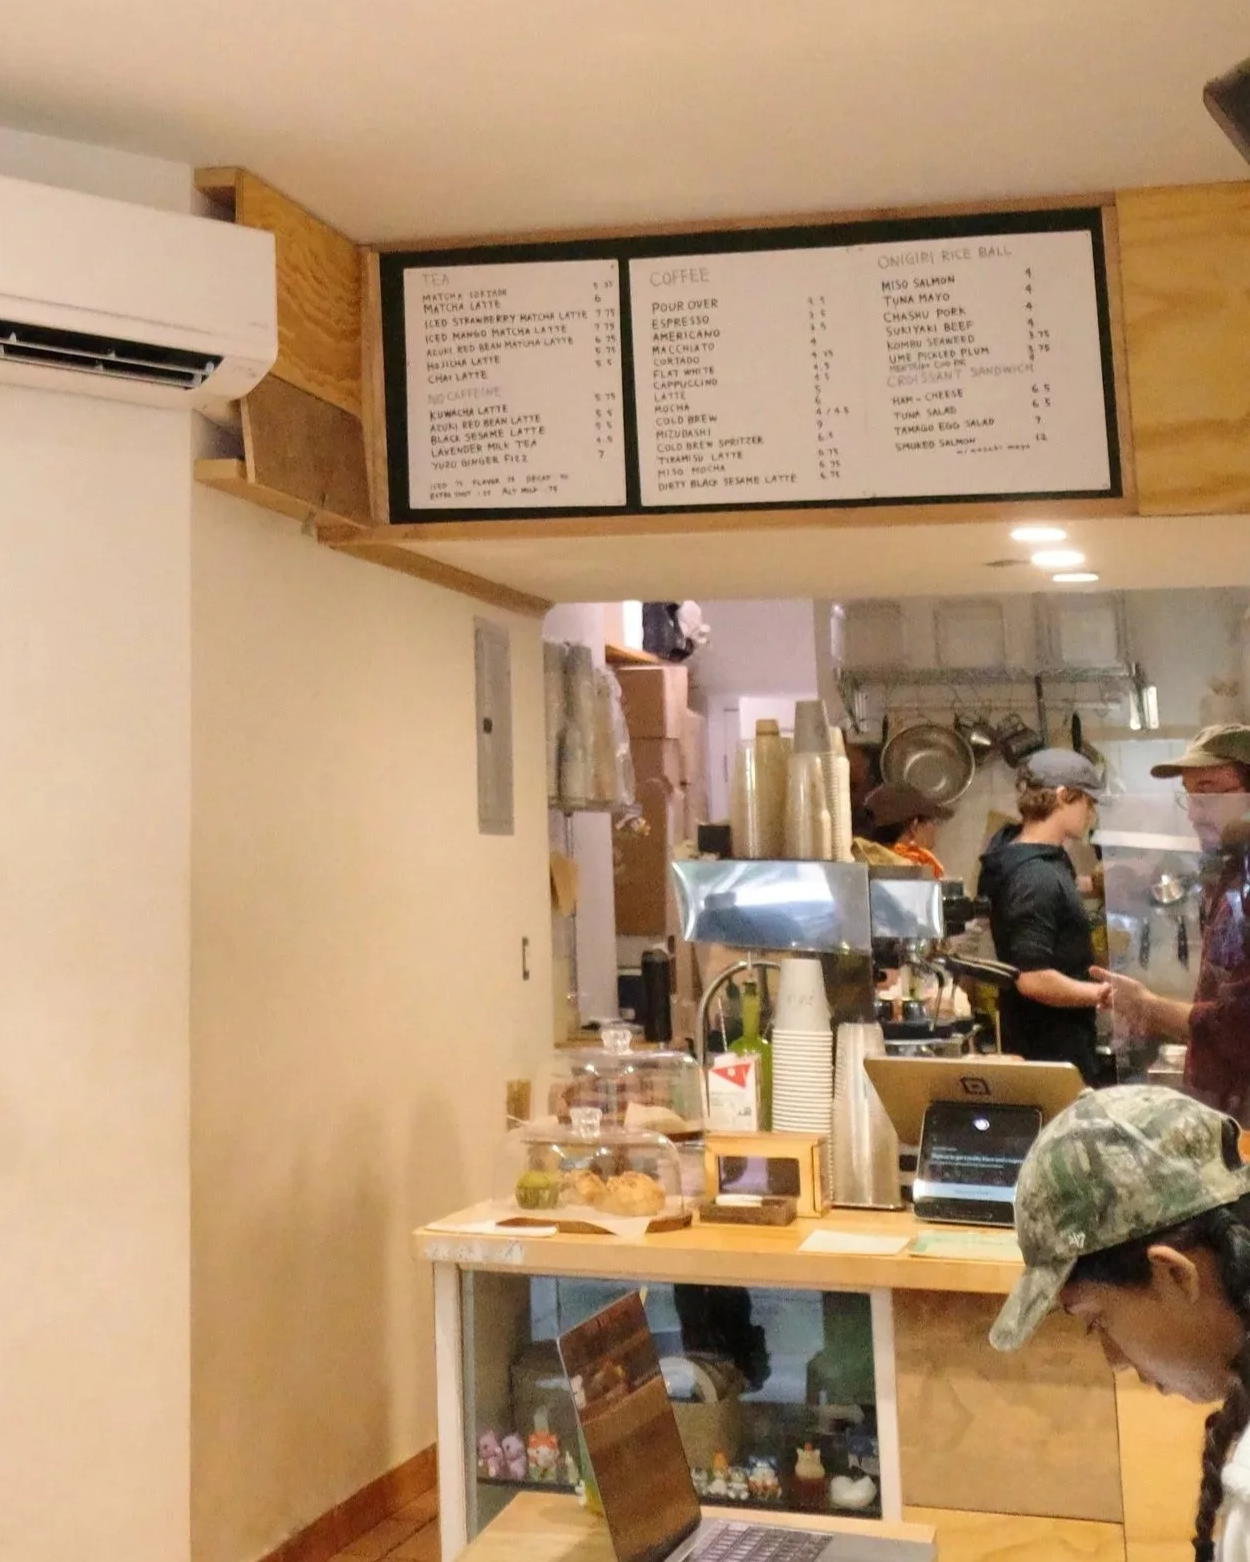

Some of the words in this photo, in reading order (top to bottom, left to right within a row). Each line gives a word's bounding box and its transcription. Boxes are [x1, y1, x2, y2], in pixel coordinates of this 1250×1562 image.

[878, 252, 935, 270] ONIGIRI
[942, 248, 971, 262] RICE
[979, 245, 1012, 258] BALL
[422, 273, 449, 286] TEA
[650, 268, 710, 287] COFFEE
[882, 280, 909, 291] MISO
[914, 275, 955, 288] SALMON
[422, 292, 462, 304] MATCHA
[652, 301, 684, 314] POUR
[687, 298, 718, 311] OVER
[884, 295, 914, 308] TUNA
[919, 292, 950, 302] MAYO
[423, 302, 464, 314] MATCHA
[470, 300, 500, 311] LATTE
[884, 310, 929, 323] CHASHU
[937, 307, 966, 318] PORK
[425, 319, 447, 329] ICED
[452, 315, 516, 326] STRAWBERRY
[520, 312, 555, 322] MATCHA
[559, 310, 588, 320] LATTE
[652, 316, 710, 329] ESPRESSO
[425, 334, 447, 343] ICED
[452, 330, 487, 340] MANGO
[492, 328, 530, 337] MATCHA
[535, 325, 567, 334] LATTE
[652, 329, 721, 342] AMERICANO
[886, 324, 938, 337] SUKIYAKI
[944, 320, 973, 332] BEEF
[457, 344, 475, 354] RED
[480, 341, 501, 352] BEAN
[504, 338, 541, 350] MATCHA
[544, 336, 574, 347] LATTE
[652, 342, 715, 355] MACCHIATO
[887, 339, 922, 351] KOMBU
[927, 335, 975, 347] SEAWEED
[471, 355, 500, 366] LATTE
[654, 357, 700, 366] CORTADO
[889, 354, 911, 364] UME
[918, 350, 956, 360] PICKLED
[961, 347, 990, 357] PLUM
[456, 370, 488, 381] LATTE
[653, 369, 679, 379] FLAT
[683, 366, 714, 376] WHITE
[886, 370, 962, 388] CROISSANT
[971, 364, 1036, 378] SANDWICH
[428, 393, 444, 405] NO
[447, 387, 502, 402] CAFFEINE
[655, 392, 686, 402] LATTE
[893, 396, 913, 406] HAM
[925, 389, 964, 402] CHEESE
[430, 408, 474, 420] KUWACHA
[478, 404, 508, 416] LATTE
[655, 404, 690, 414] MOCHA
[894, 411, 920, 420] TUNA
[927, 406, 957, 417] SALAD
[462, 419, 480, 430] RED
[483, 416, 507, 428] BEAN
[511, 414, 541, 425] LATTE
[656, 416, 684, 426] COLD
[687, 414, 718, 425] BREW
[894, 424, 934, 436] TAMAGO
[938, 422, 959, 432] EGG
[965, 418, 995, 428] SALAD
[430, 434, 460, 446] BLACK
[465, 430, 504, 442] SESAME
[510, 425, 546, 436] LATTE
[656, 429, 711, 439] MIZUDASHI
[432, 444, 482, 458] LAVENDER
[488, 441, 509, 452] MILK
[517, 439, 537, 449] TEA
[657, 442, 683, 453] COLD
[686, 440, 713, 451] BREW
[718, 436, 764, 448] SPRITZER
[895, 441, 935, 452] SMOKED
[939, 437, 976, 448] SALMON
[462, 455, 498, 467] GINGER
[658, 453, 704, 464] TIRAMISU
[711, 451, 743, 462] LATTE
[658, 468, 684, 478] MISO
[692, 465, 726, 474] MOCHA
[658, 480, 686, 492] DIRTY
[723, 476, 759, 487] SESAME
[765, 474, 797, 484] LATTE
